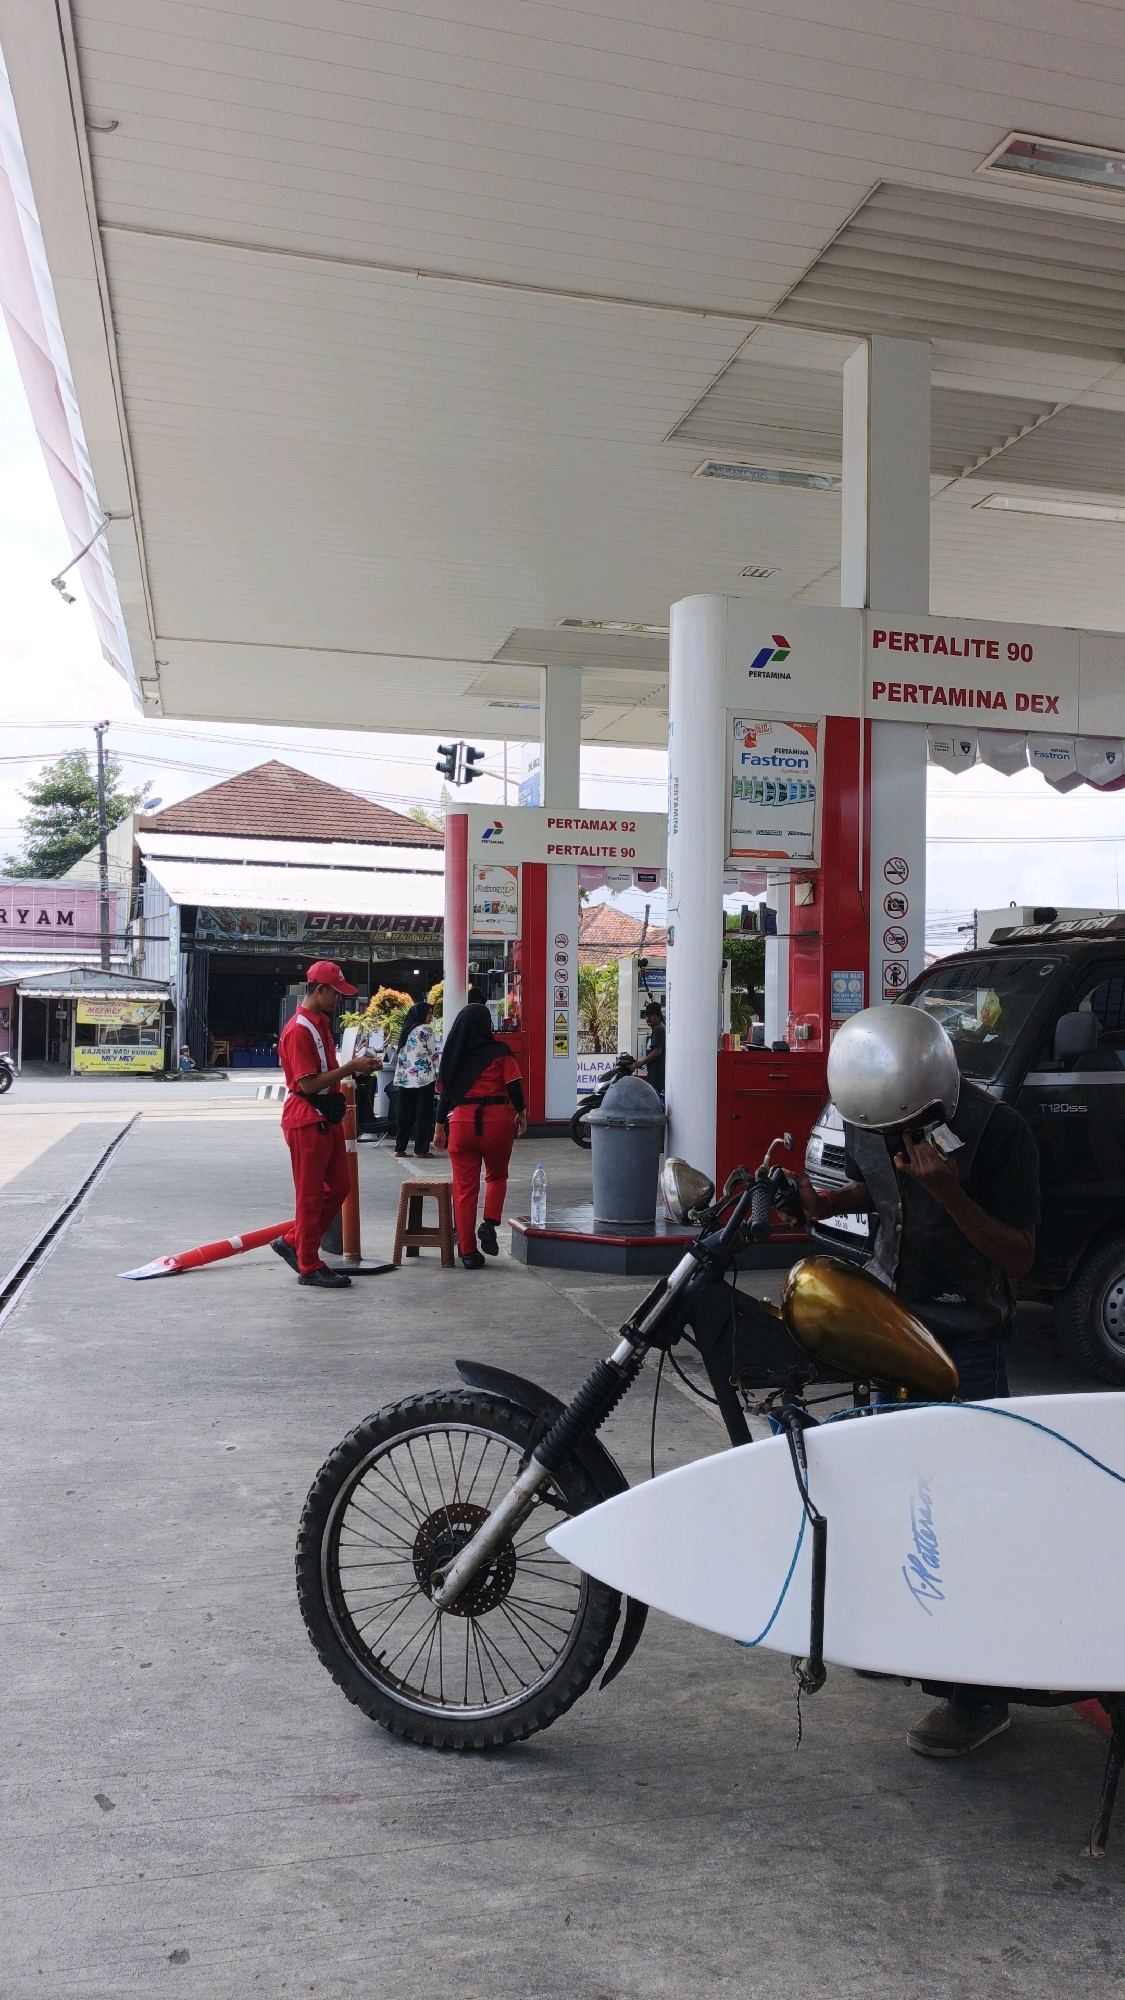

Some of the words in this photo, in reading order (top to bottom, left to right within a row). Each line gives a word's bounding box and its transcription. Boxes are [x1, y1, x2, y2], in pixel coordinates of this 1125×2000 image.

[873, 629, 999, 660] PERTALITE
[1007, 642, 1034, 663] 90
[748, 670, 791, 680] PERTAMINA
[872, 681, 1008, 711] PERTAMINA
[1015, 693, 1060, 715] DEX
[774, 747, 809, 756] PERTAMINA
[1033, 750, 1070, 760] Fastron
[741, 752, 809, 769] Fastron
[547, 818, 617, 832] PERTAMAX
[620, 821, 636, 832] 92
[547, 844, 617, 857] PERTALITE
[620, 847, 636, 858] 90
[1006, 923, 1052, 938] TIGA
[1047, 915, 1118, 934] PUTRI
